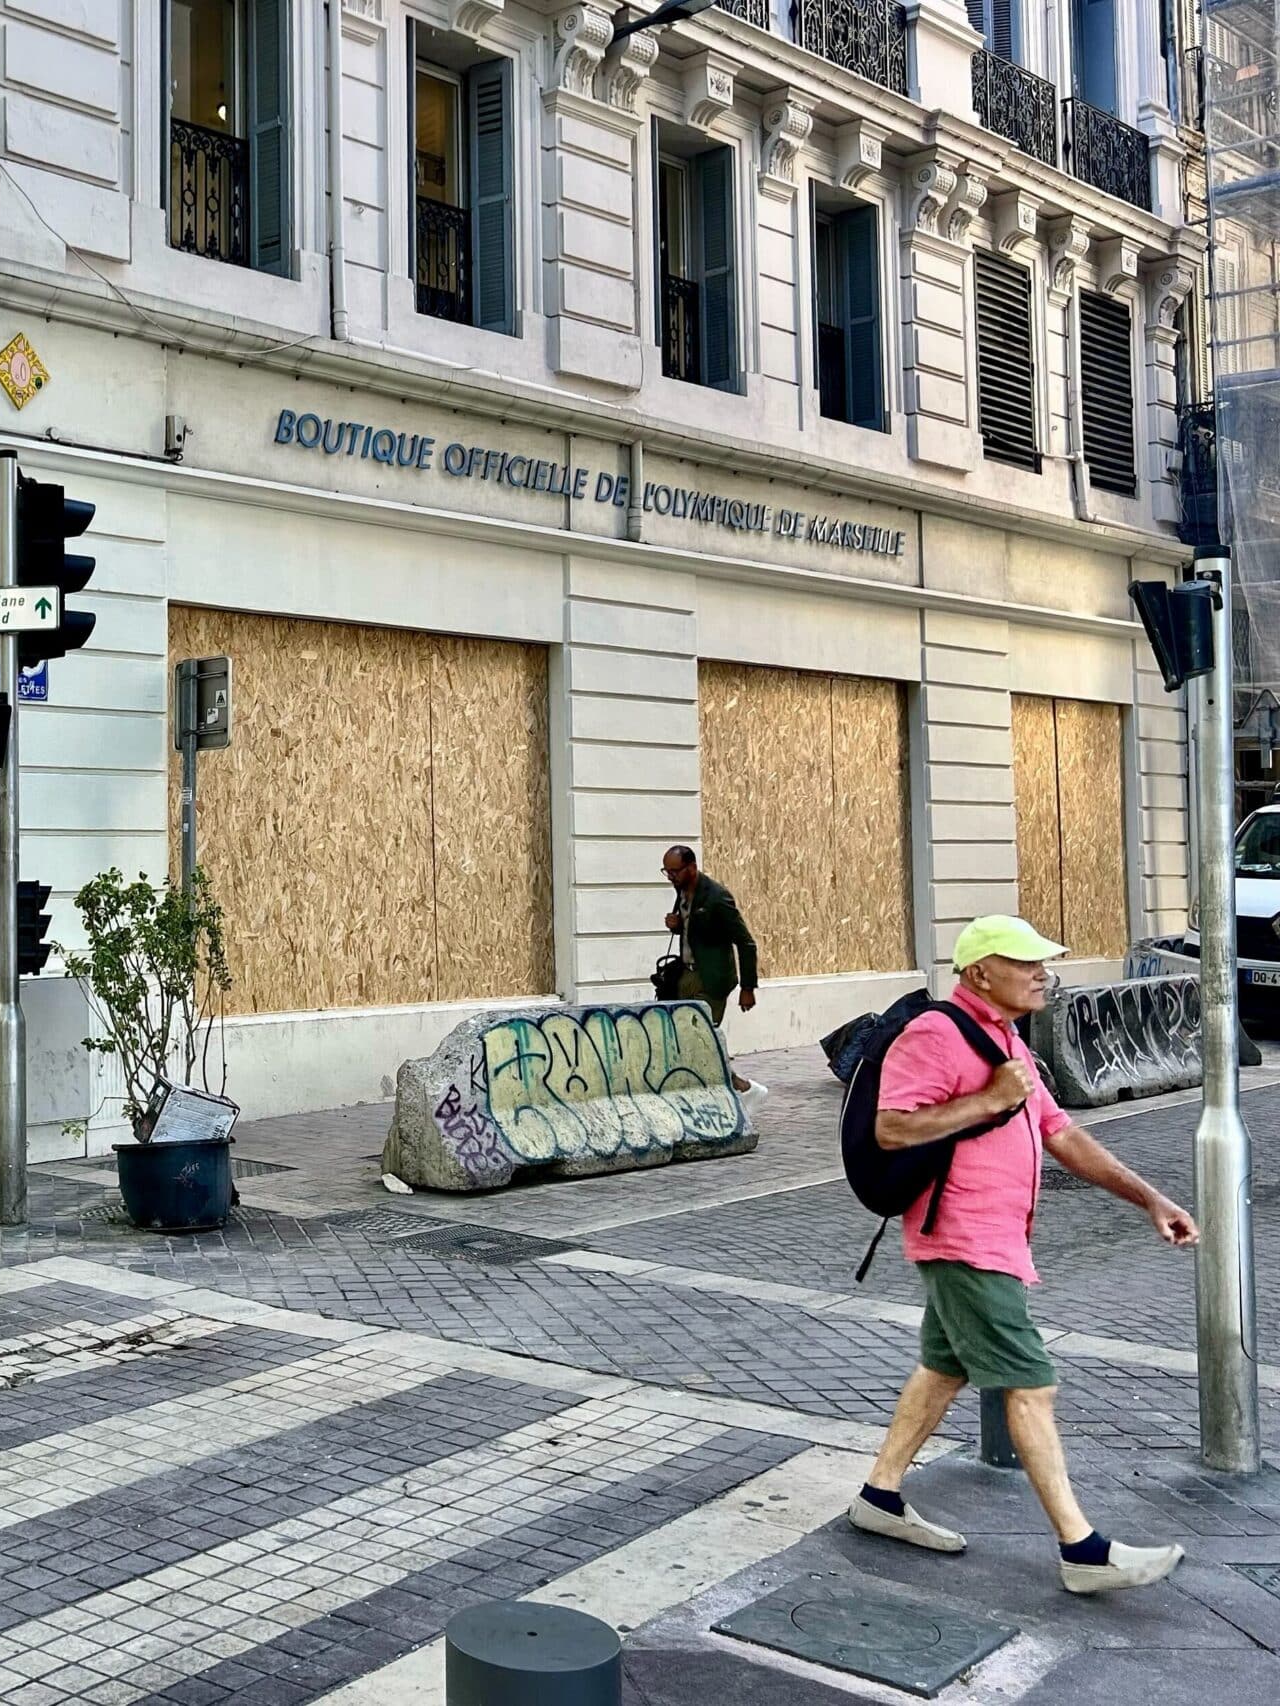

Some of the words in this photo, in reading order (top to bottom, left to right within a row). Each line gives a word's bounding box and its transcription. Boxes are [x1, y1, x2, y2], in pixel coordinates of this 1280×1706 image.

[274, 409, 435, 469] BOUTIQUE
[444, 443, 589, 499] OFFICIELLE
[595, 472, 628, 506] DE
[643, 482, 771, 532] L'OLYMPIQUE
[776, 509, 807, 539] DE
[808, 514, 906, 557] MARSEILLE
[1253, 971, 1280, 985] DQ-4
